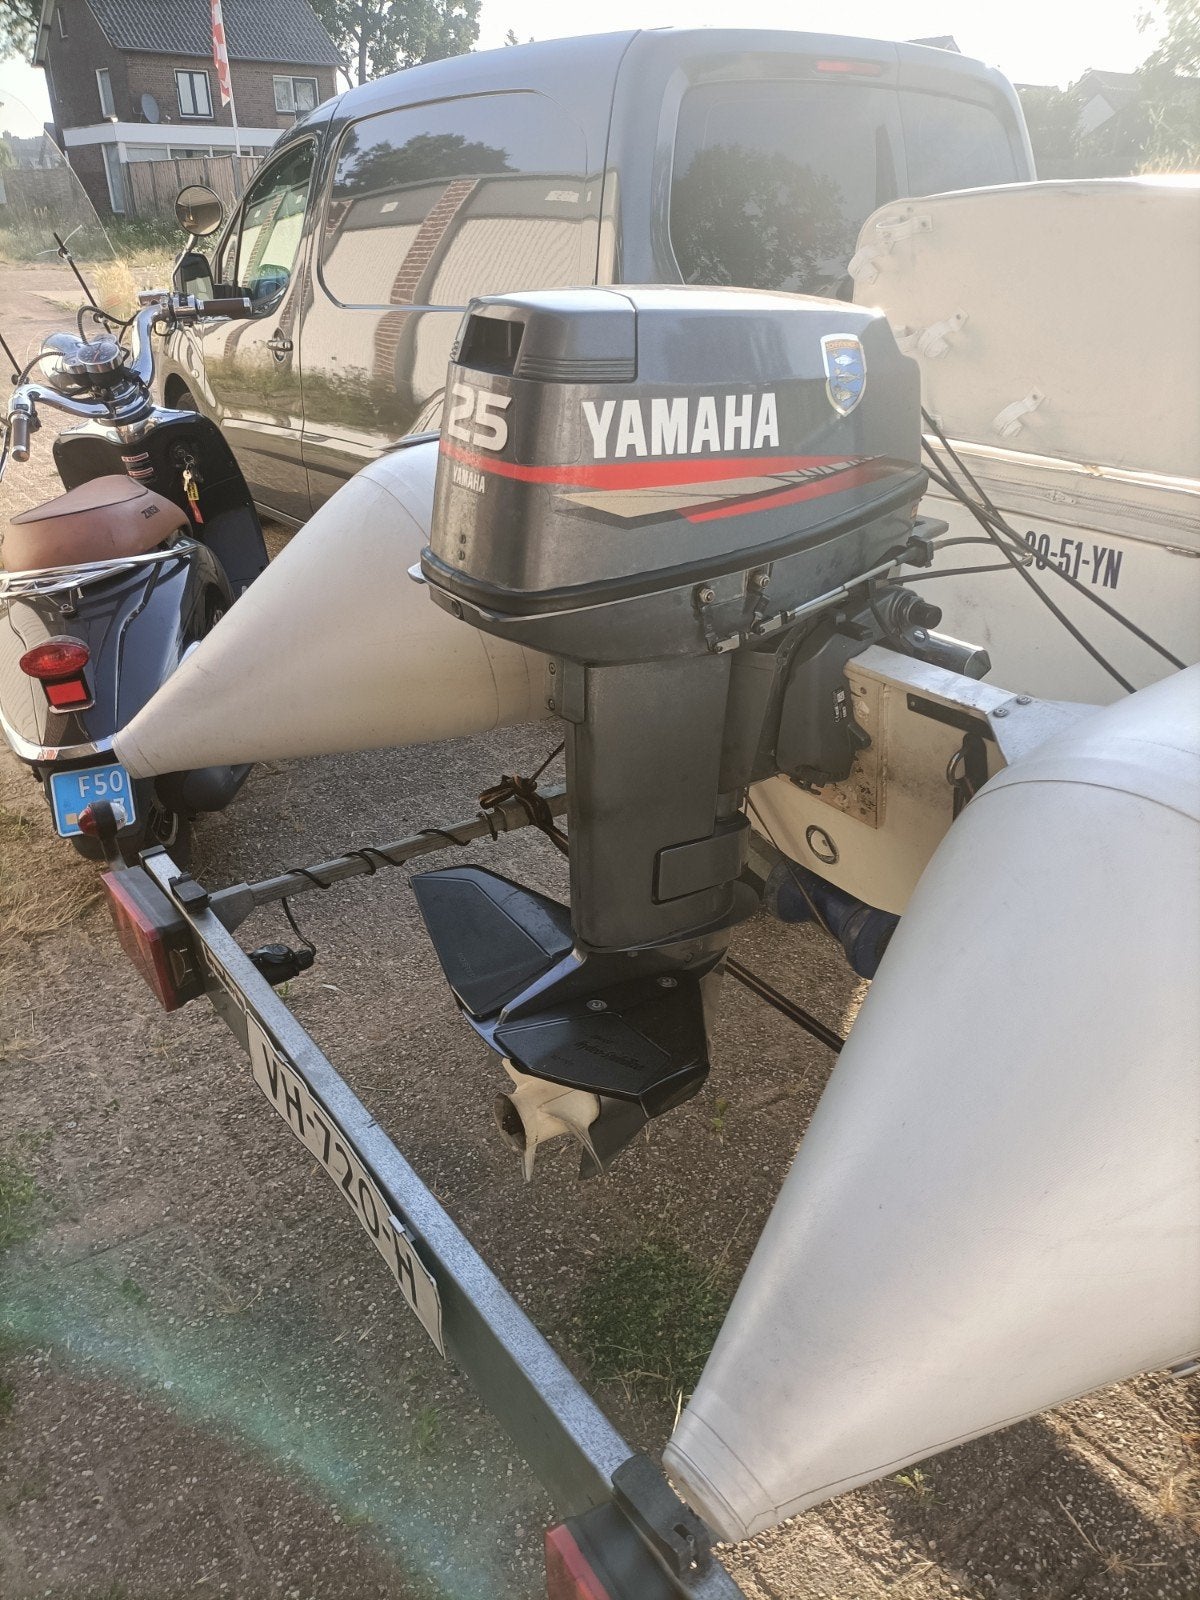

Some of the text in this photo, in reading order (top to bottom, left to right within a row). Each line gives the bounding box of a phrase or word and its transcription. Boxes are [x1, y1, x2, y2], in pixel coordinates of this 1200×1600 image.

[448, 383, 512, 451] 25
[582, 393, 780, 459] YAMAHA
[453, 465, 485, 493] YAMAHA
[79, 770, 123, 797] F50
[262, 1043, 418, 1308] VH-720-H
